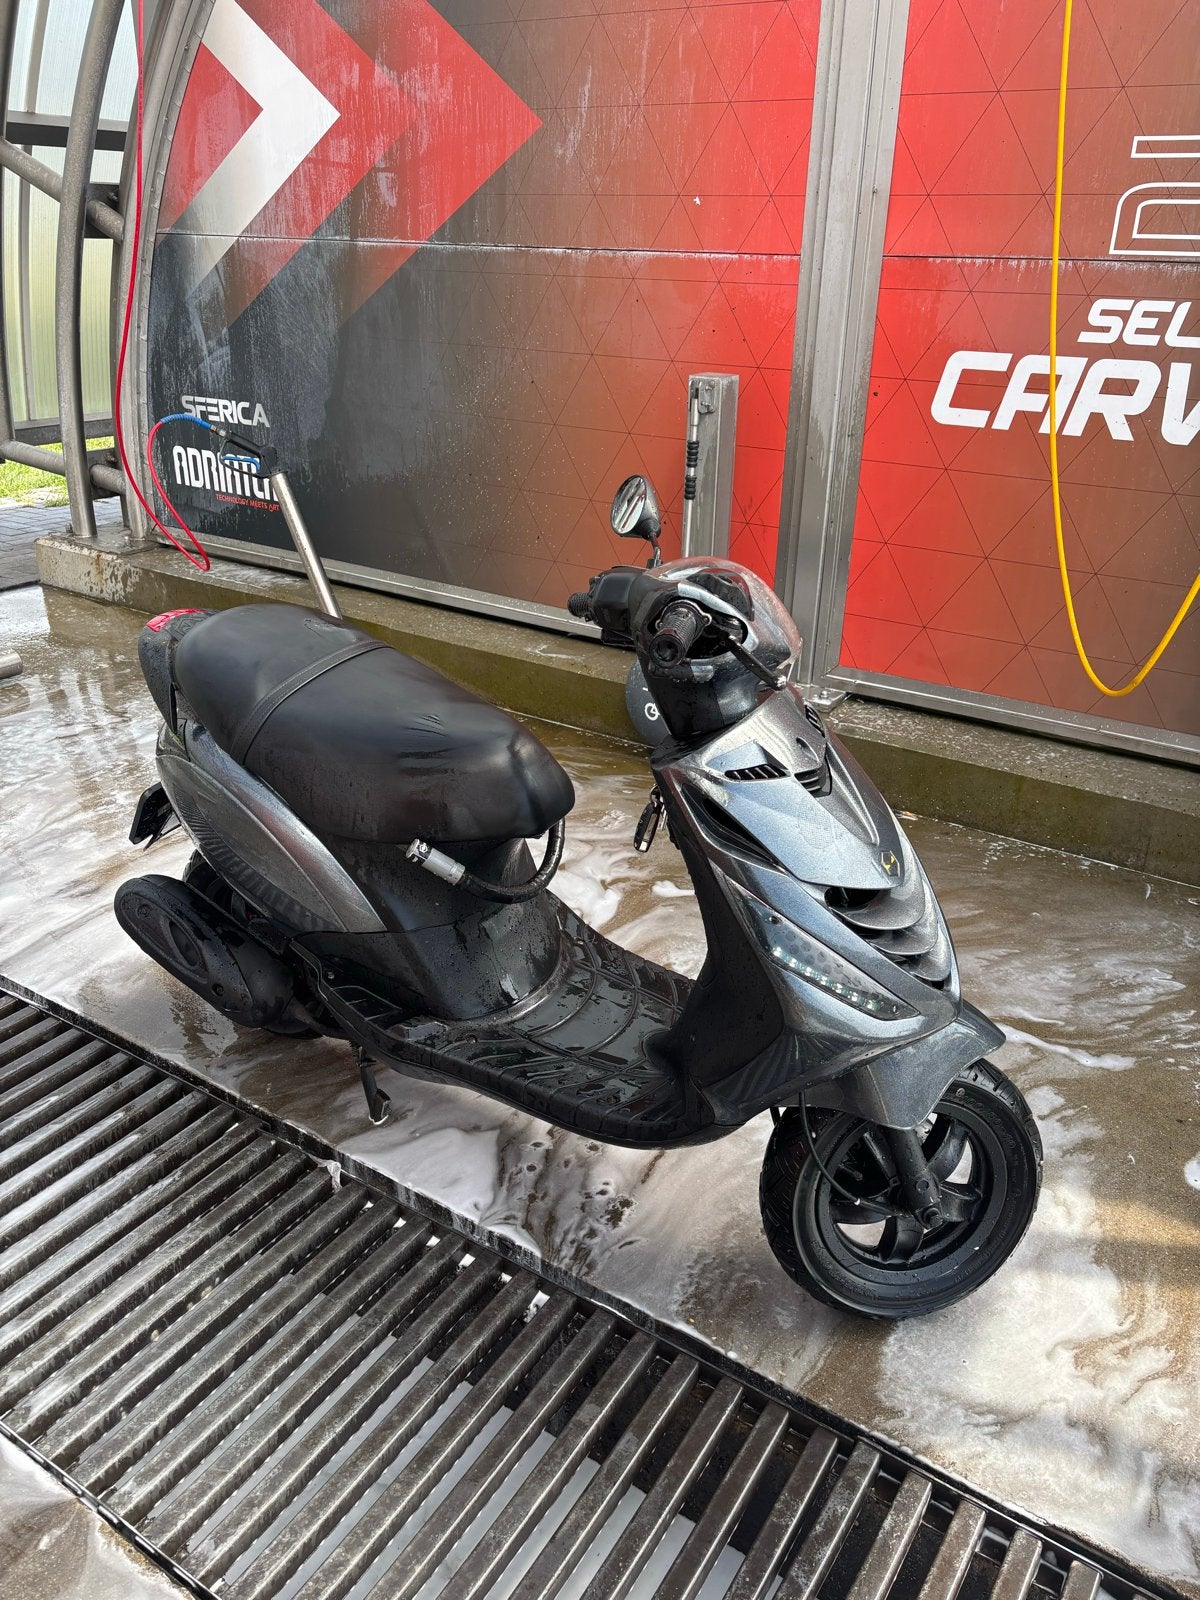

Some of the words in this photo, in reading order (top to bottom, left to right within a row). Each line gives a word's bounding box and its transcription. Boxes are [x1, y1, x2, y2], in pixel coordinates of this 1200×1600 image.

[181, 394, 270, 428] SFERICA
[215, 493, 249, 506] TECHNOLOGY
[249, 500, 268, 510] MEETS
